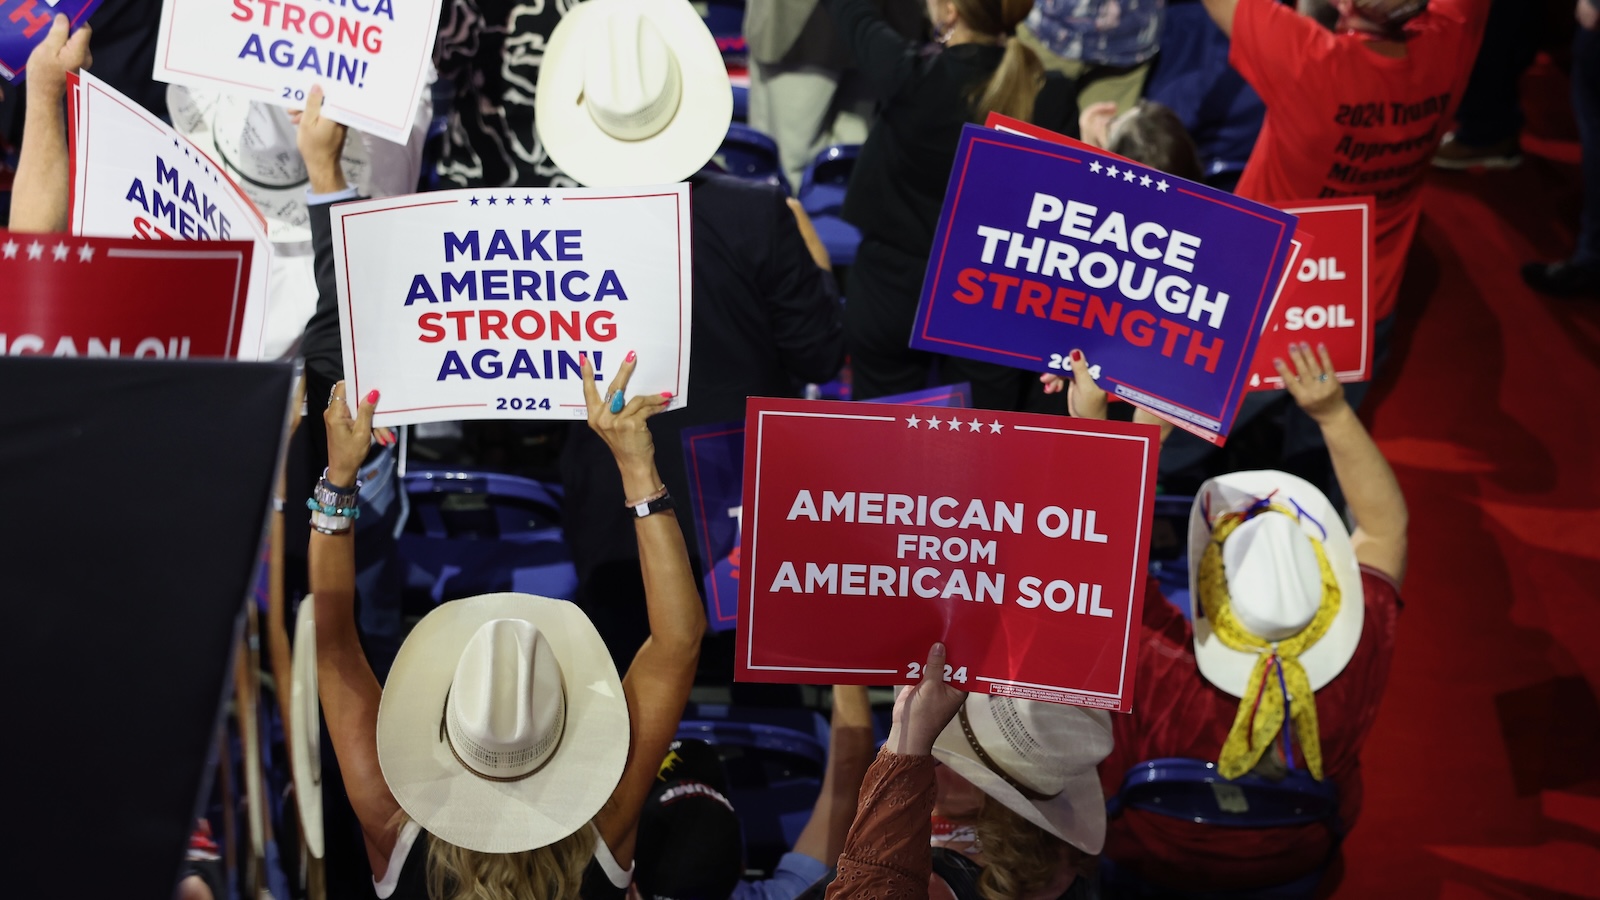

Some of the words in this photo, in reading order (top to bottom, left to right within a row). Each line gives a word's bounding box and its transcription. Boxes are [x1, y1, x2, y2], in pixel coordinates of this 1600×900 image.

[231, 0, 383, 54] STRONG
[238, 33, 368, 88] AGAIN!
[282, 87, 325, 107] 20
[156, 155, 231, 241] MAKE
[443, 229, 583, 263] MAKE
[1027, 192, 1202, 273] PEACE
[977, 225, 1230, 330] THROUGH
[1296, 256, 1346, 282] OIL
[403, 269, 628, 306] AMERICA
[418, 309, 617, 343] STRONG
[952, 268, 1225, 374] STRENGTH
[1284, 304, 1355, 331] SOIL
[436, 348, 604, 381] AGAIN!
[1047, 353, 1102, 380] 204
[496, 397, 551, 411] 2024
[786, 489, 1024, 534] AMERICAN
[1036, 505, 1109, 544] OIL
[896, 534, 997, 565] FROM
[769, 561, 1005, 605] AMERICAN
[1015, 576, 1114, 618] SOIL
[905, 662, 968, 684] 224
